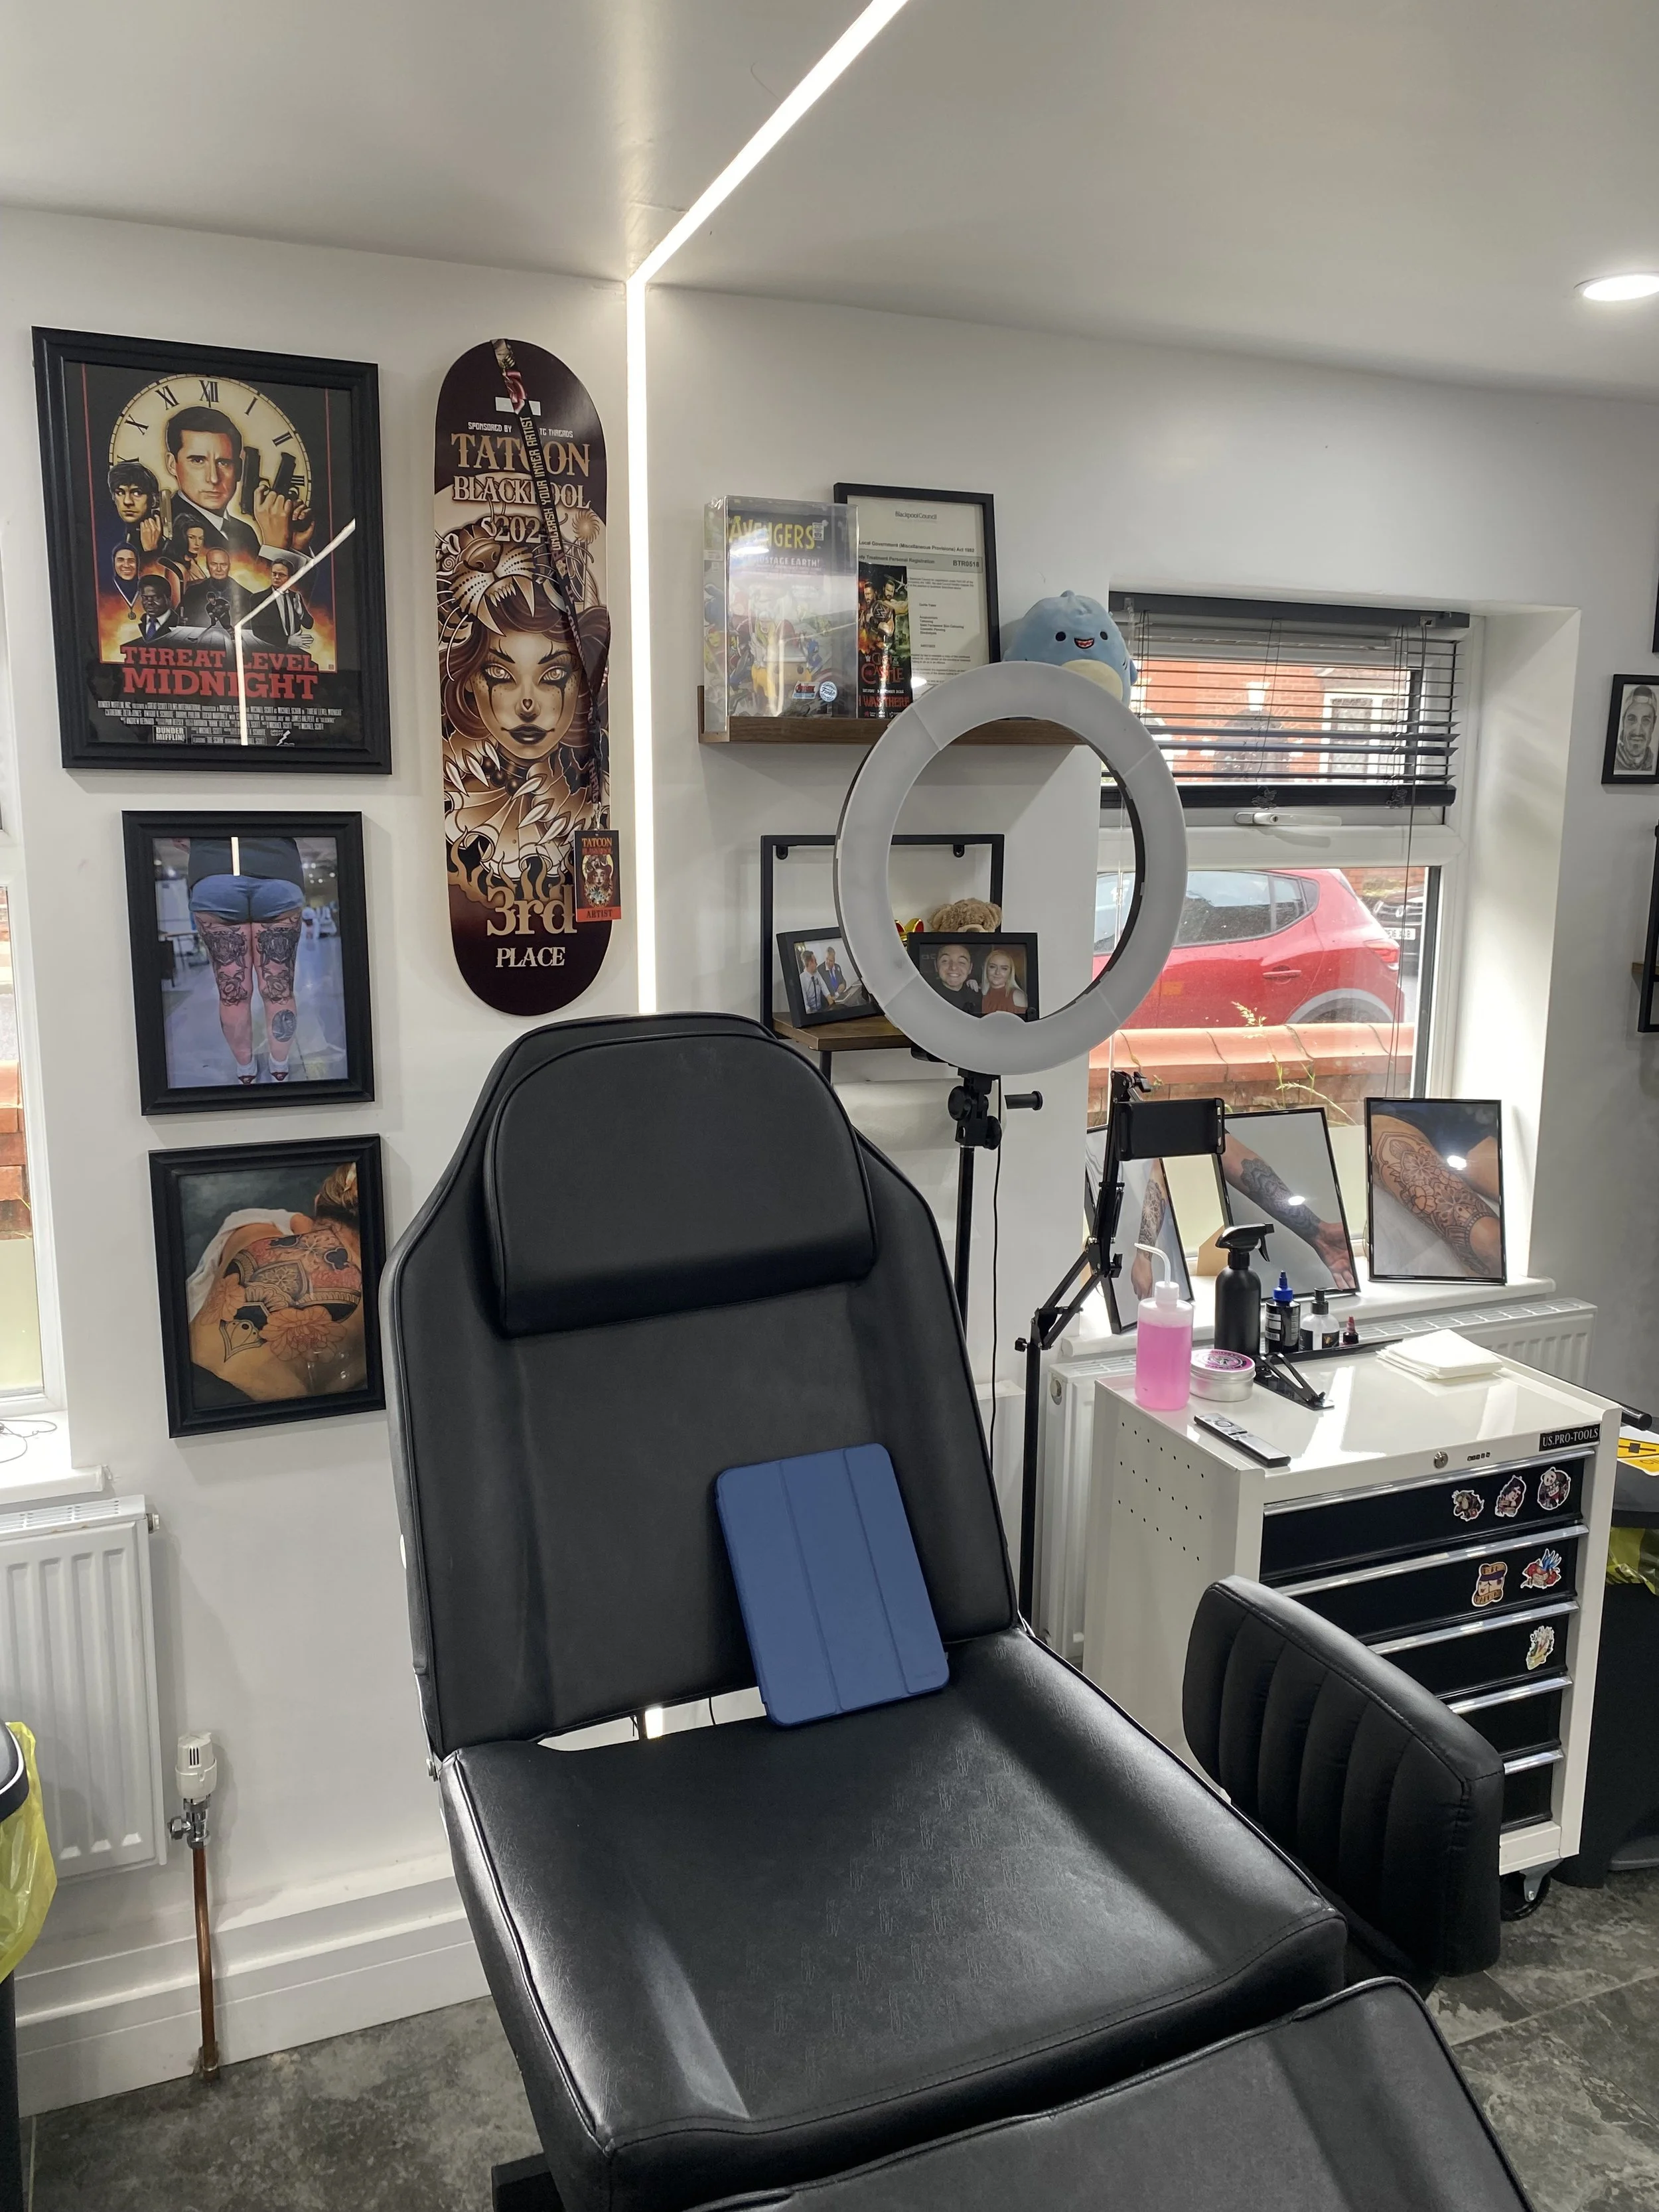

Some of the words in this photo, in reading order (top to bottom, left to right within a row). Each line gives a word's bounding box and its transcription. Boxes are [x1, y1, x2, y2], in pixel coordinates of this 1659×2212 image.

[468, 421, 502, 432] SPONSORED
[548, 429, 573, 438] THREADS
[520, 417, 538, 447] ARTIST
[529, 449, 545, 478] INNER
[453, 475, 591, 509] BLACKOOL
[537, 480, 551, 505] YOUR
[494, 515, 549, 544] 202
[543, 508, 561, 551] UNLEASH
[791, 557, 820, 567] EARTH!
[121, 646, 226, 668] THREAT
[122, 668, 318, 700] MIDNIGHT
[581, 838, 612, 848] TATCON
[487, 885, 577, 936] 3rd
[587, 909, 613, 919] ARTIST
[496, 946, 566, 968] PLACE
